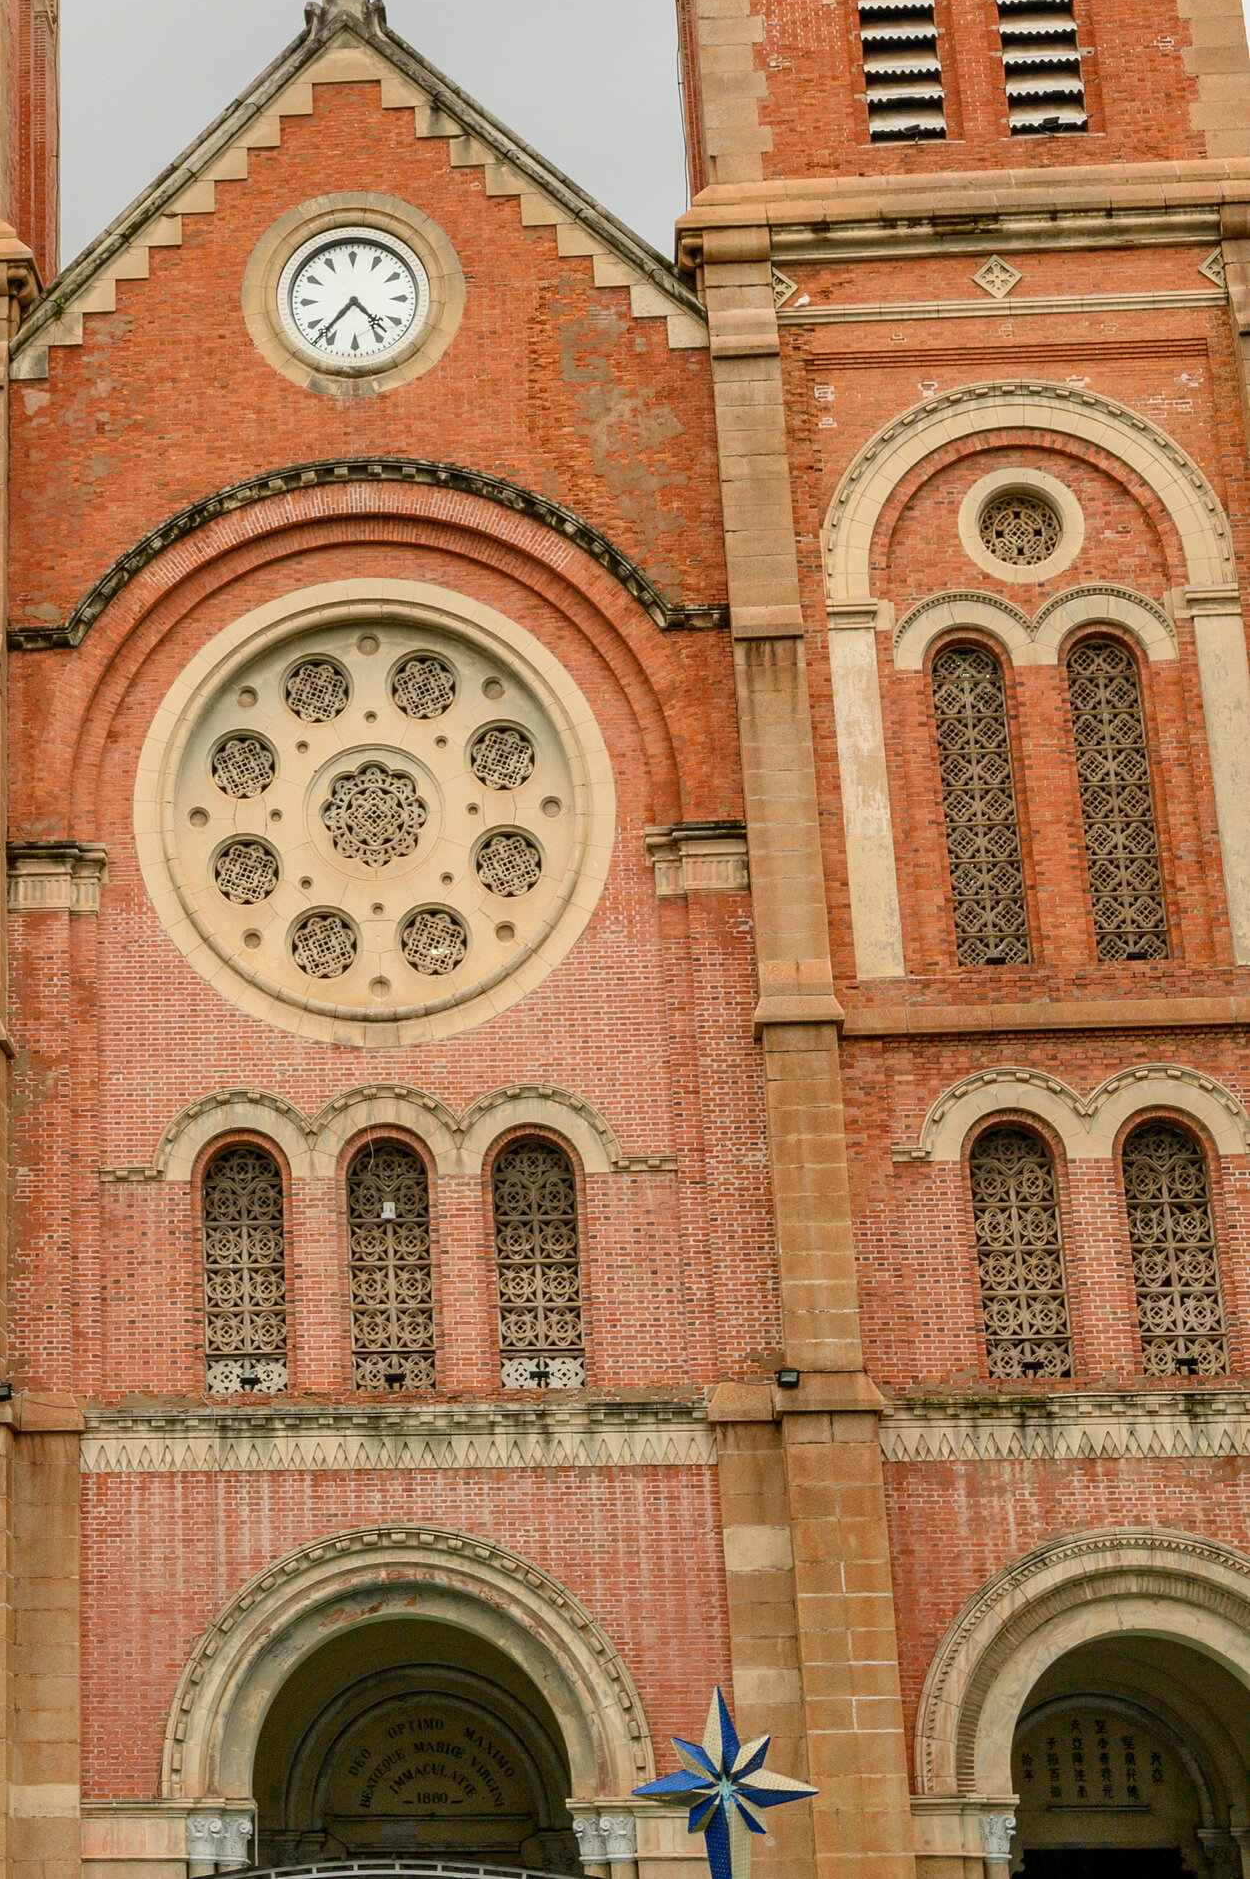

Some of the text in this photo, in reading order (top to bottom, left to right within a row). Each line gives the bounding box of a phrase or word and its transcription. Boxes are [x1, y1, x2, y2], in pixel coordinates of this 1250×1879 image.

[348, 1717, 514, 1777] DEO OPTIMO MAXIMO
[417, 1792, 448, 1804] 1880
[471, 1756, 505, 1808] VIRGINI
